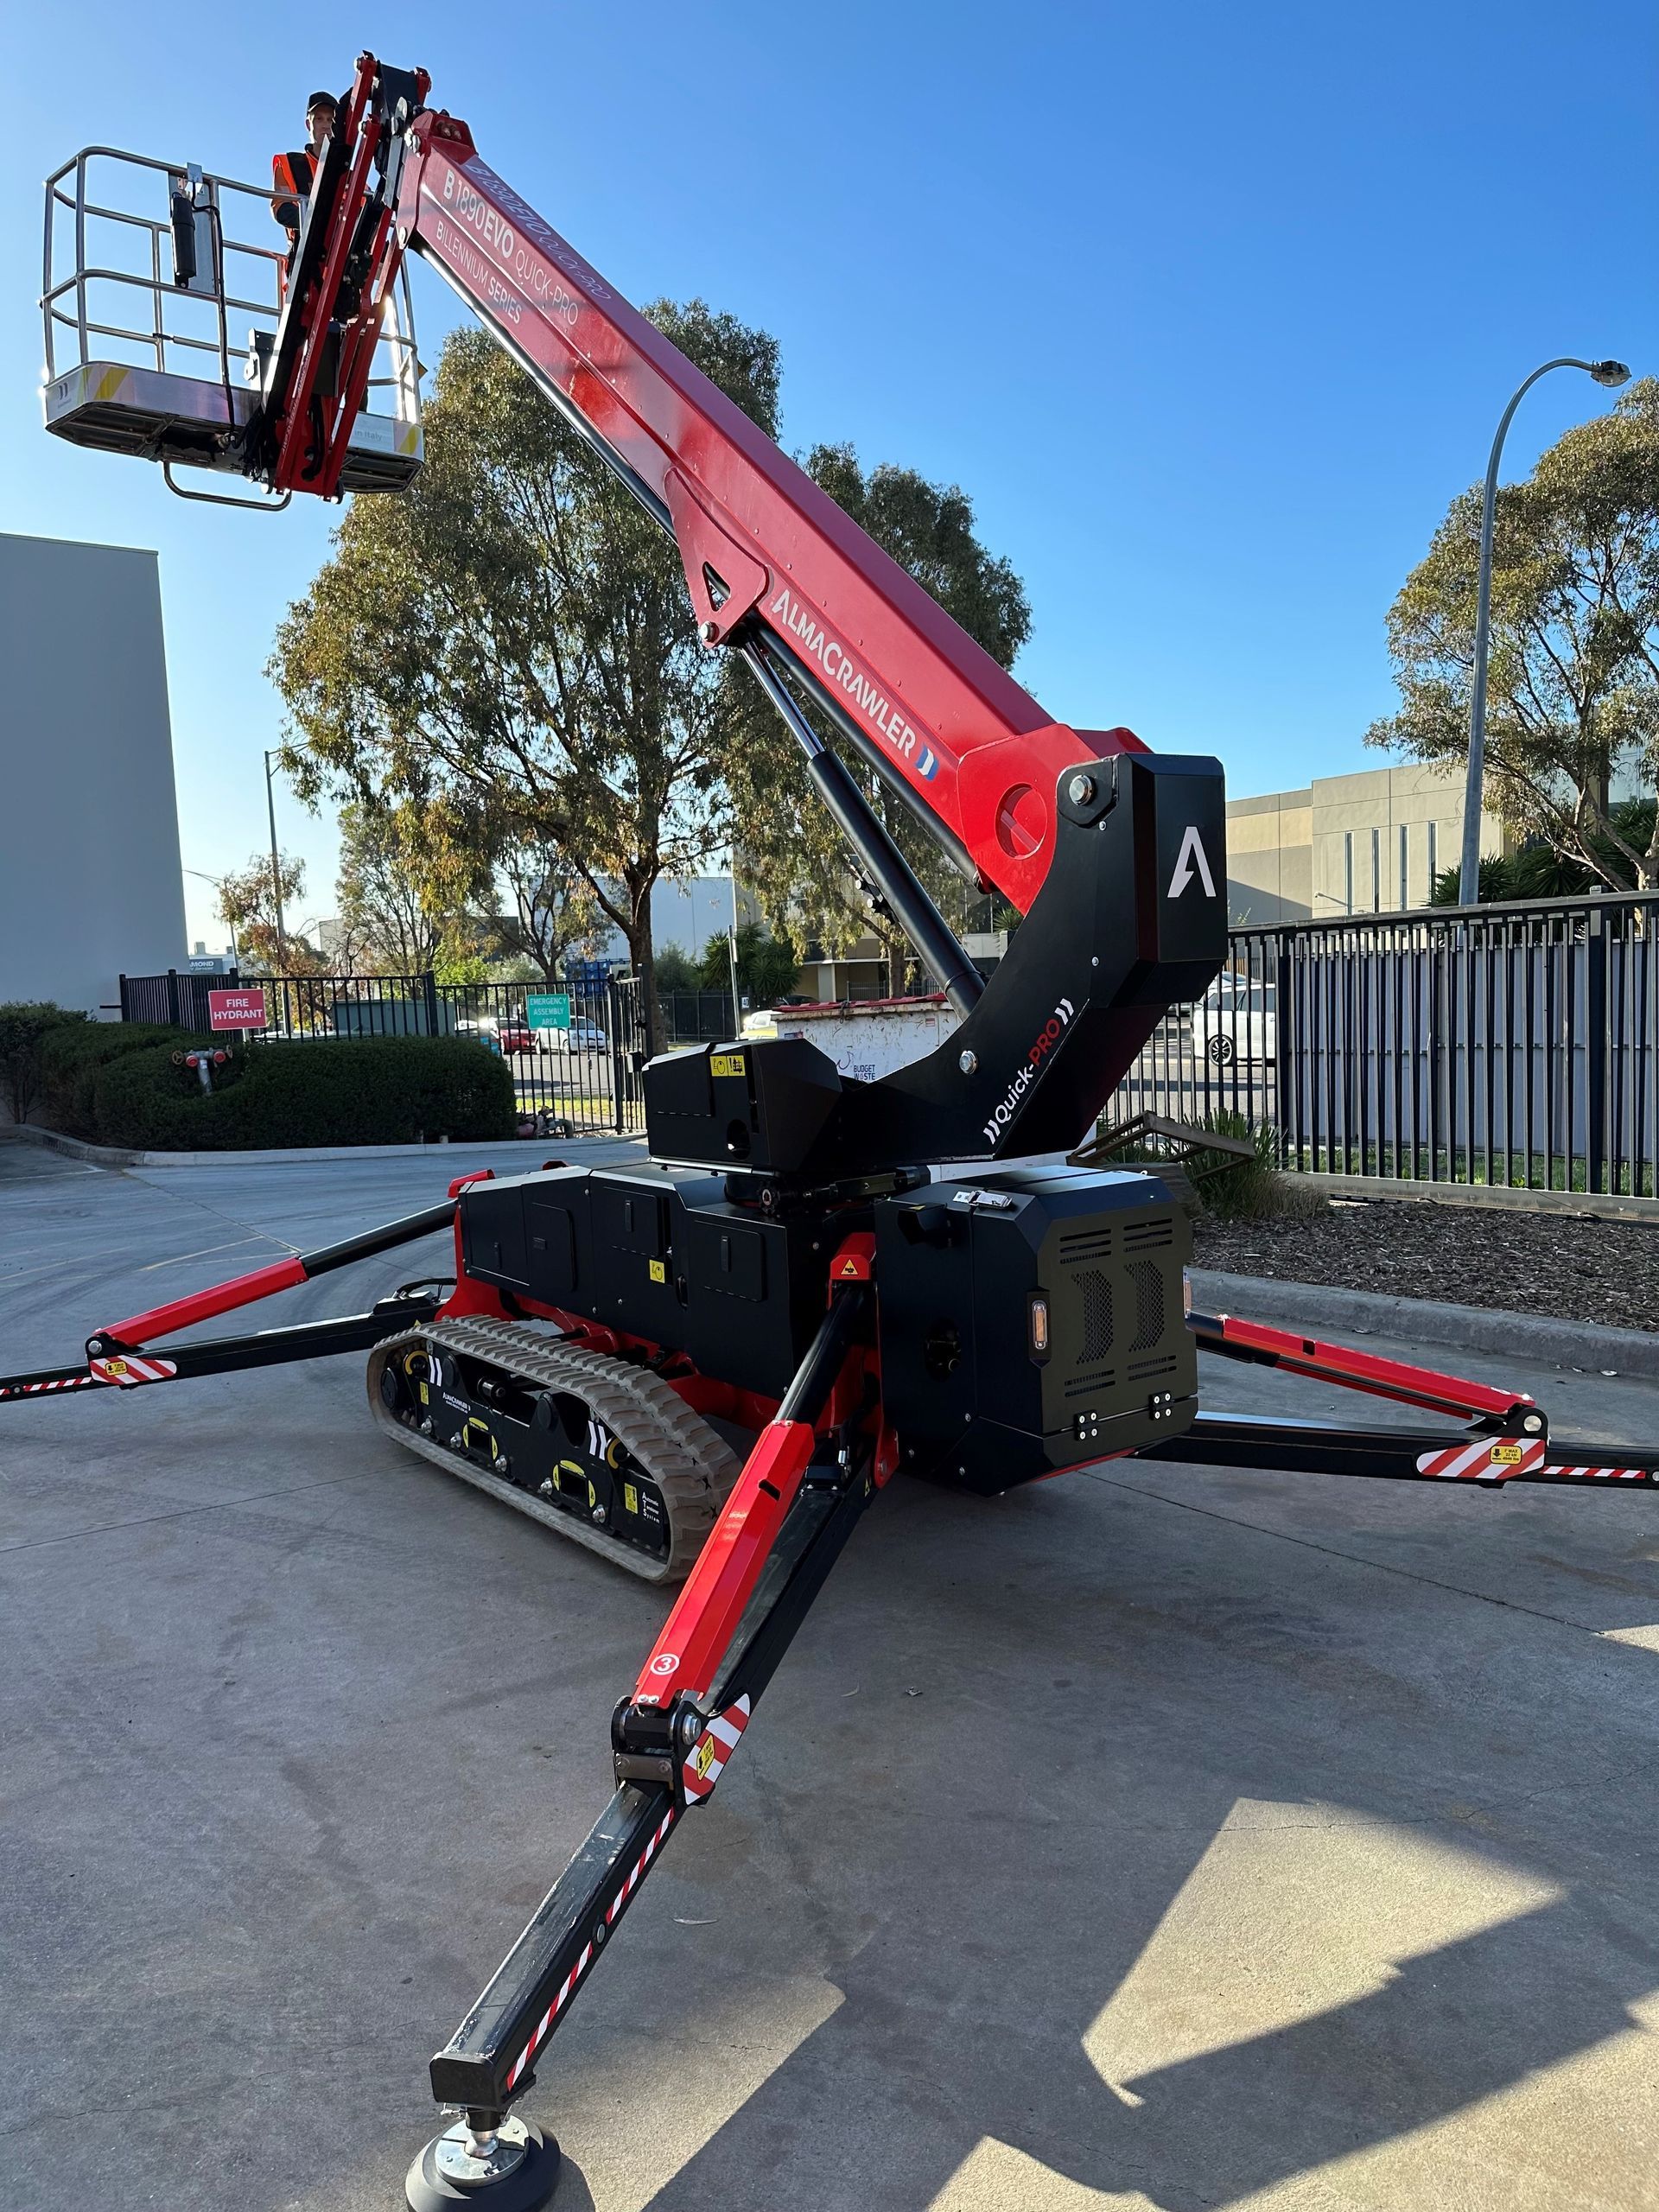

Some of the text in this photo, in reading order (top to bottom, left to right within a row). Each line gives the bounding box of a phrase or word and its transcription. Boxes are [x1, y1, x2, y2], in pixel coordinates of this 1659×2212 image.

[435, 219, 523, 325] BILLENNIUM SERIES
[515, 249, 579, 326] QUICK-PRO
[365, 431, 383, 442] Italy
[771, 588, 917, 760] ALMACRAWLER
[1166, 825, 1217, 899] A
[226, 998, 249, 1008] FIRE
[530, 997, 567, 1006] EMERGENCY
[213, 1009, 263, 1020] HYDRANT
[854, 1064, 876, 1072] BUDGET
[995, 1018, 1060, 1124] Quick-PRO
[657, 1656, 671, 1672] 3
